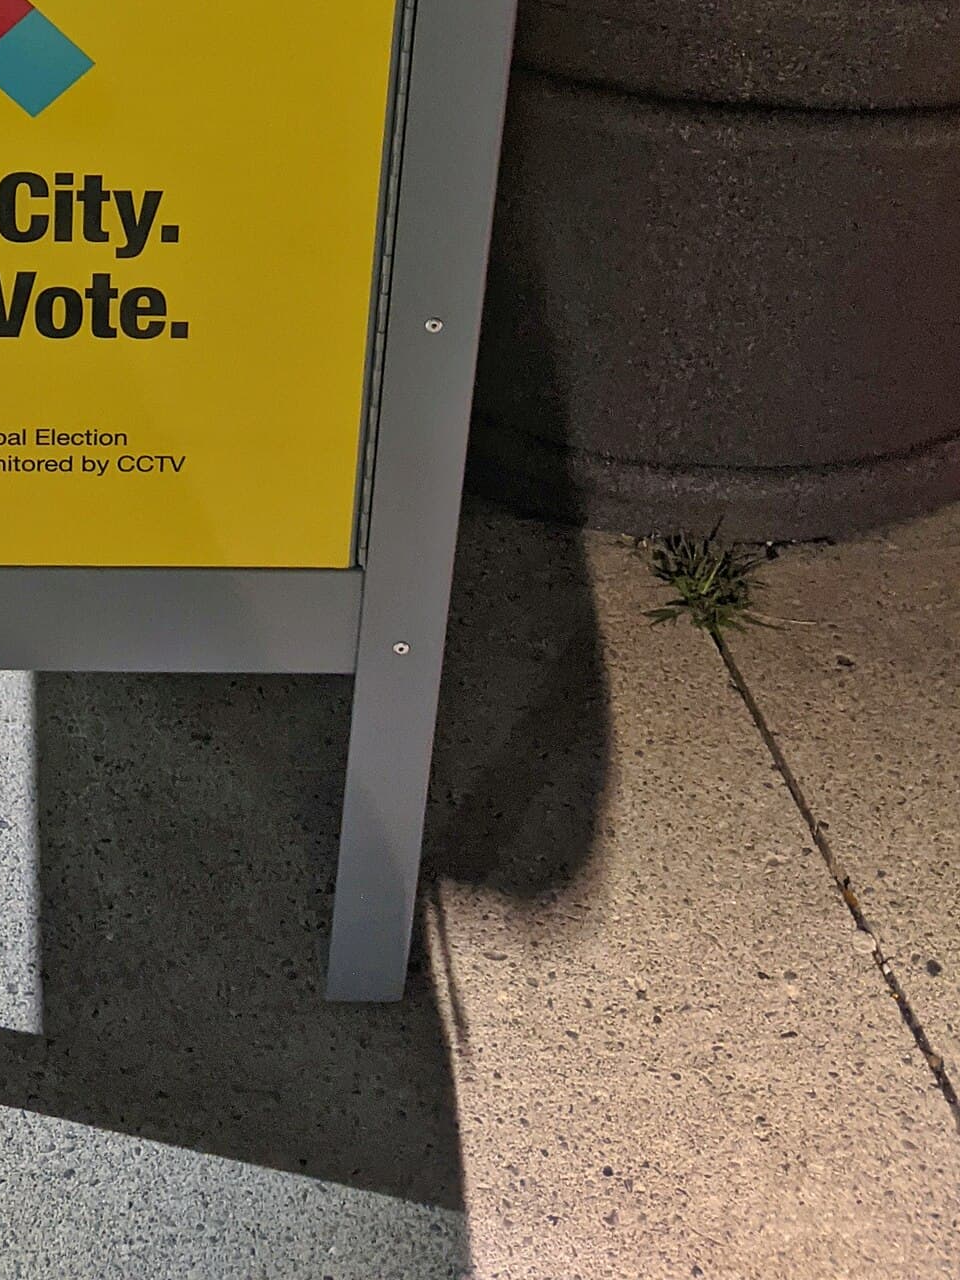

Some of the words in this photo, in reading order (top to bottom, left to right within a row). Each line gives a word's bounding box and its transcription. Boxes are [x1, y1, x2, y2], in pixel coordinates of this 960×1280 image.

[35, 428, 128, 448] Election
[81, 455, 110, 477] by
[116, 454, 186, 474] CCTV
